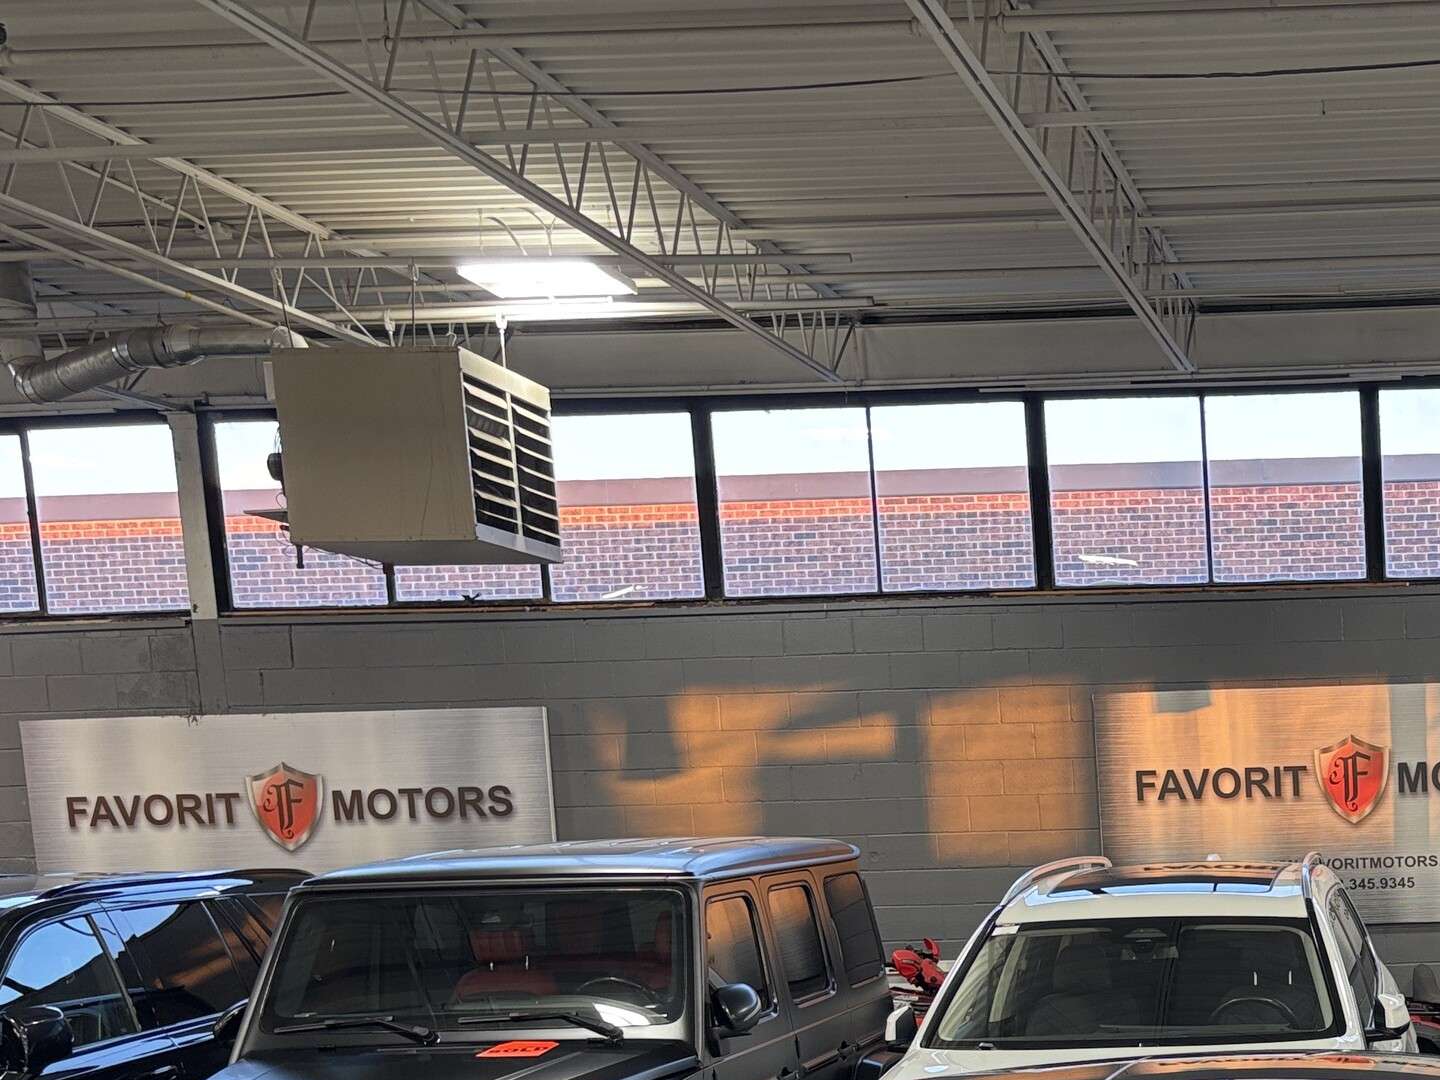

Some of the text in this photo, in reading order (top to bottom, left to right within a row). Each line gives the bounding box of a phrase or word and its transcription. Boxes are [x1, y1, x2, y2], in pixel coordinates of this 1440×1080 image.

[1135, 765, 1307, 800] FAVORIT
[66, 791, 240, 828] FAVORIT
[331, 785, 514, 822] MOTORS
[1341, 876, 1415, 890] .345.9345
